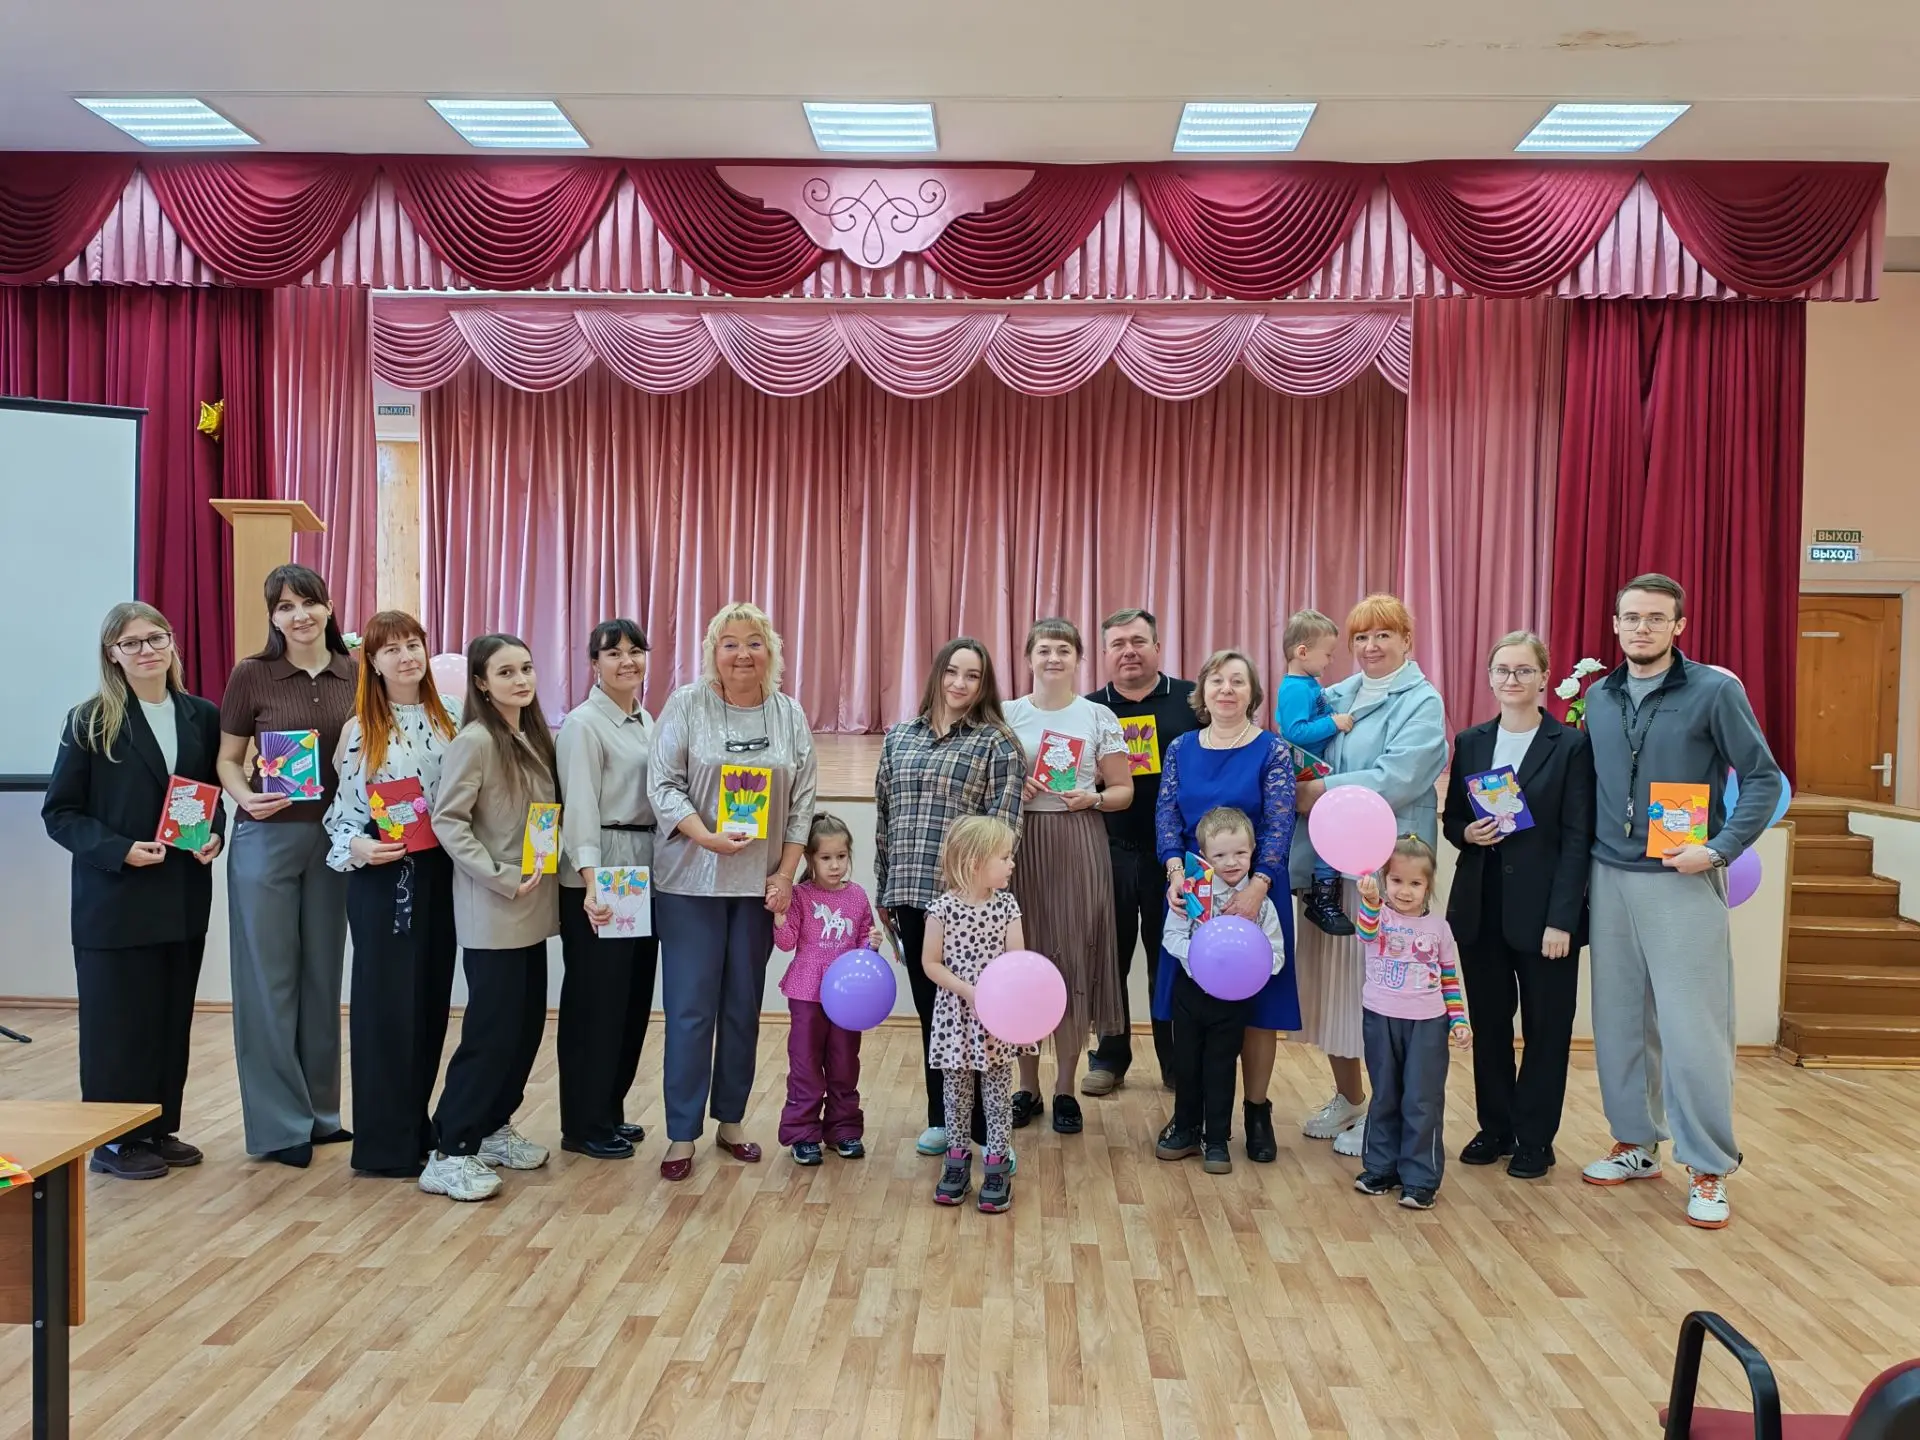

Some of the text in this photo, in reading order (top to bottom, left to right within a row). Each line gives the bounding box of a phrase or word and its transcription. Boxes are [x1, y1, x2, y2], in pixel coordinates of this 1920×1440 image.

[380, 407, 410, 415] ВЫХОД
[1818, 531, 1860, 543] ВЫХОД
[1812, 549, 1854, 560] ВЫХОД
